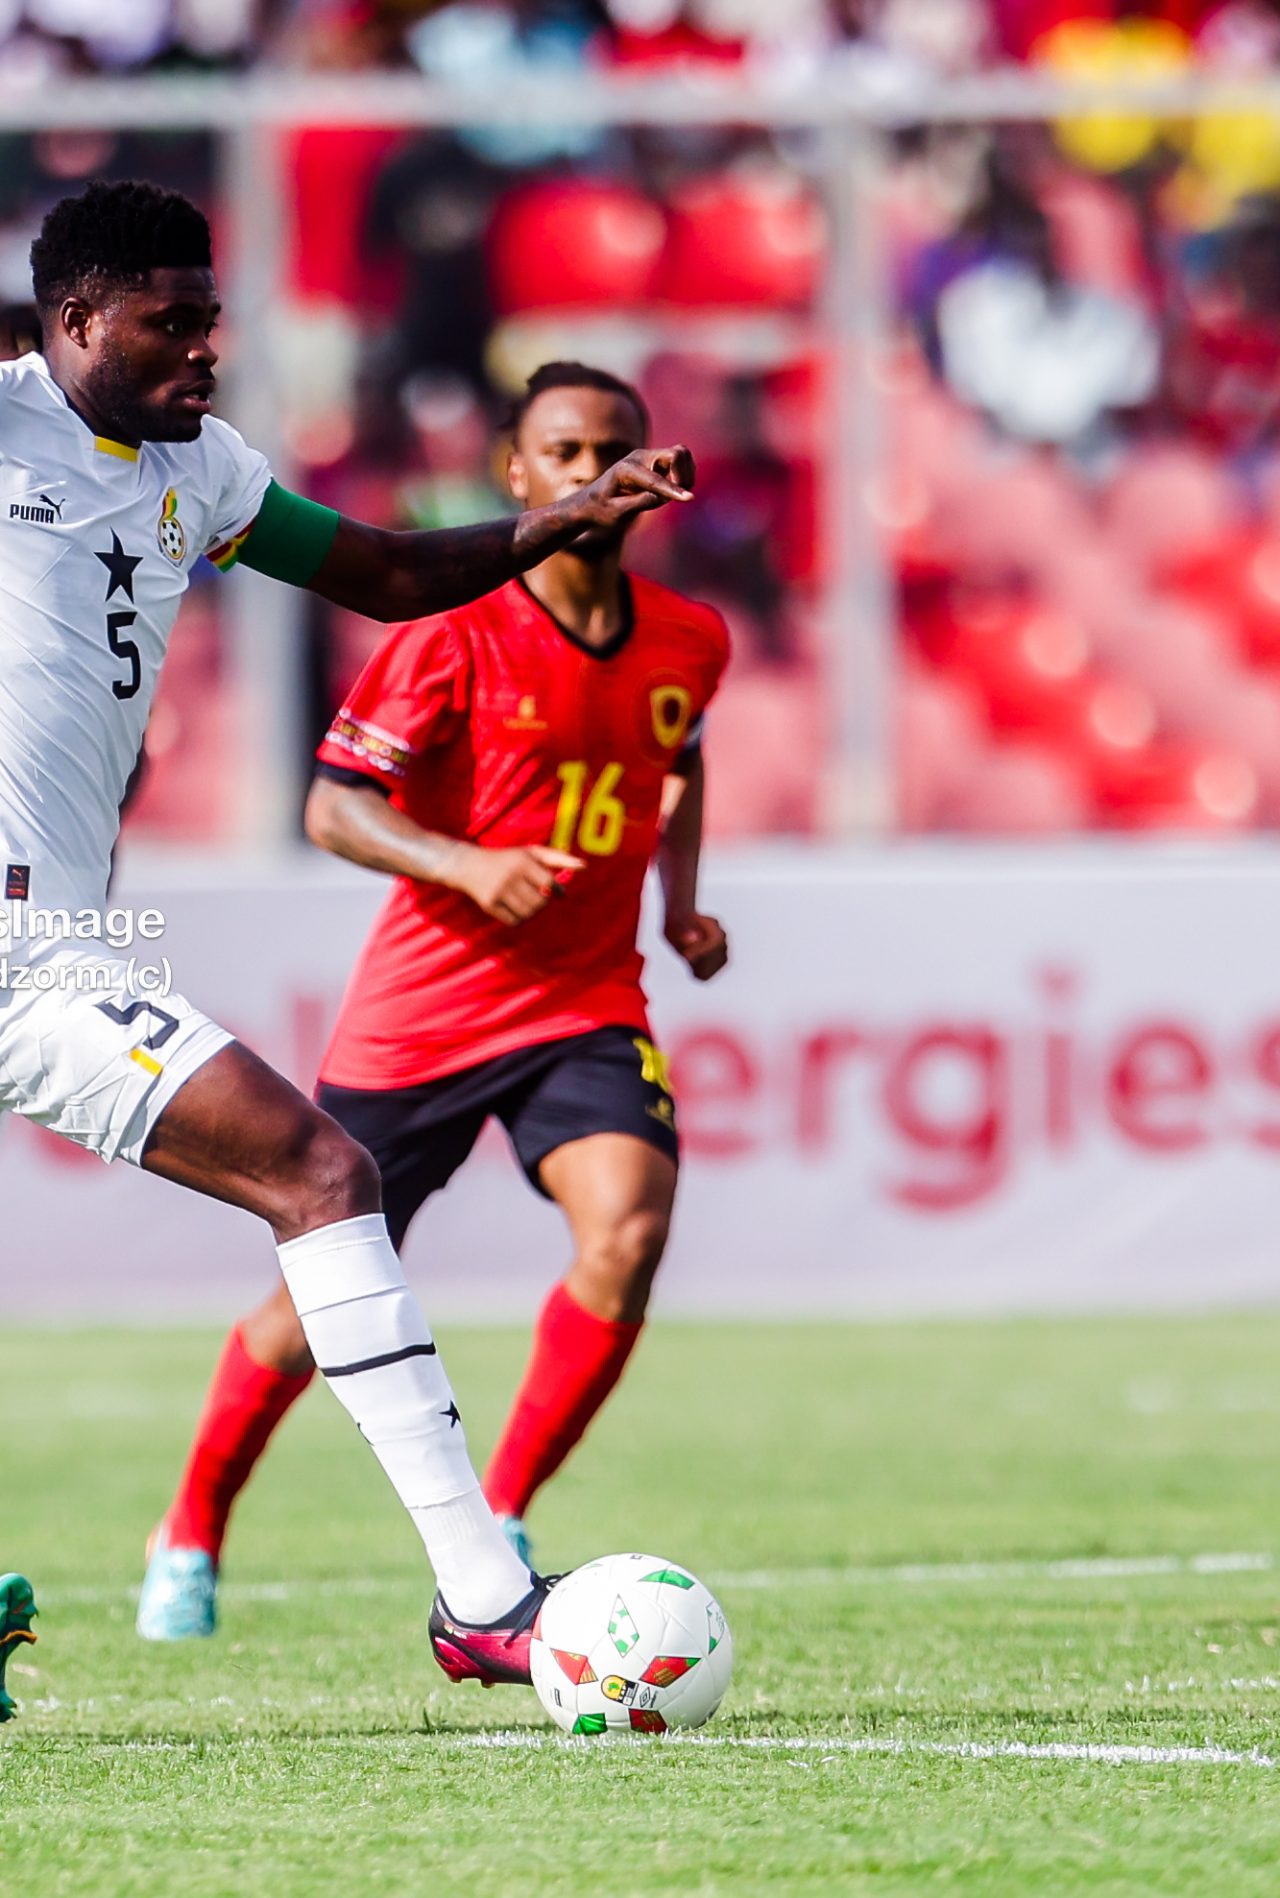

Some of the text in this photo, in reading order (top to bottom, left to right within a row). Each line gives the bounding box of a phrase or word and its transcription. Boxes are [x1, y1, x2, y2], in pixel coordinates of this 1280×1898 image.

[9, 503, 55, 524] PUMA
[106, 611, 141, 700] 5
[550, 760, 625, 855] 16
